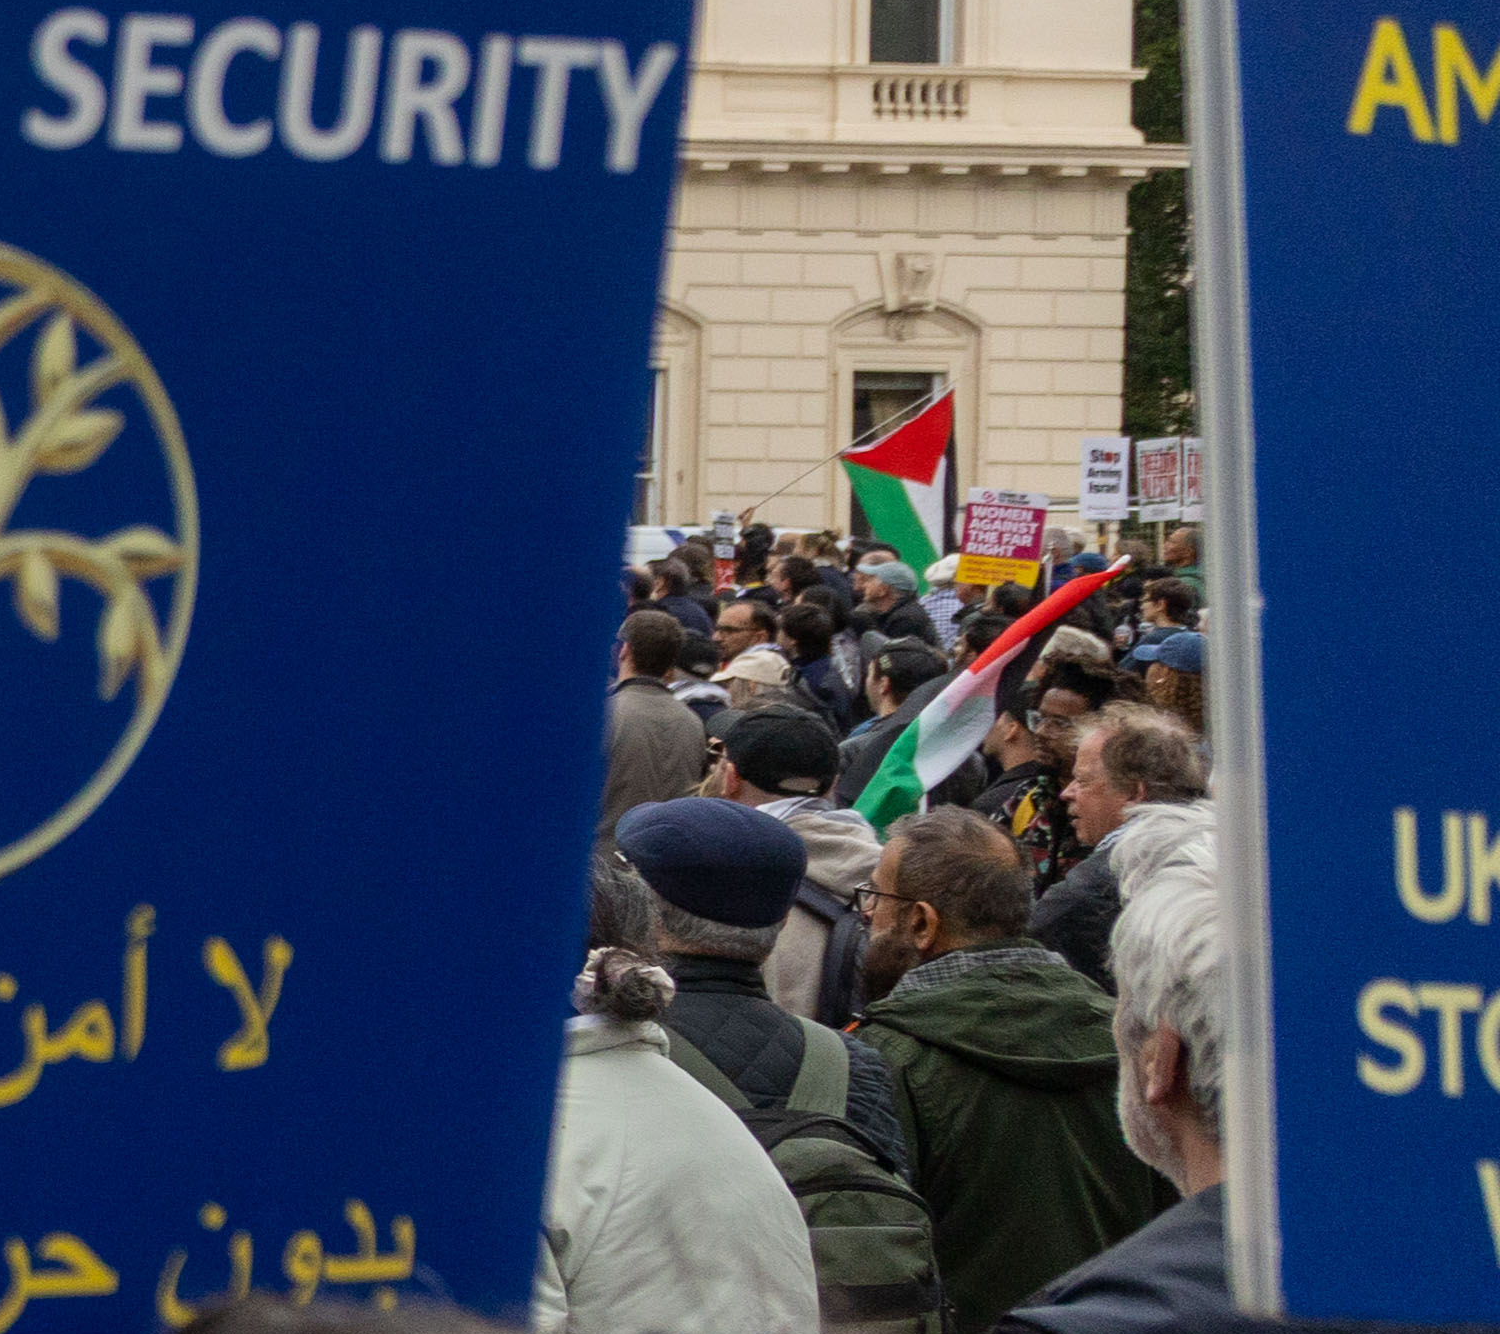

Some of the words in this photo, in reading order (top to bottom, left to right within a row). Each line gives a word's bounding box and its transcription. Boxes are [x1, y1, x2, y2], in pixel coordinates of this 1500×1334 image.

[23, 6, 680, 173] SECURITY
[972, 505, 1034, 522] WOMEN
[969, 519, 1040, 534] AGAINST
[969, 530, 999, 543] THE
[1001, 533, 1033, 547] FAR
[965, 542, 1015, 556] RIGHT
[202, 935, 295, 1070] لا
